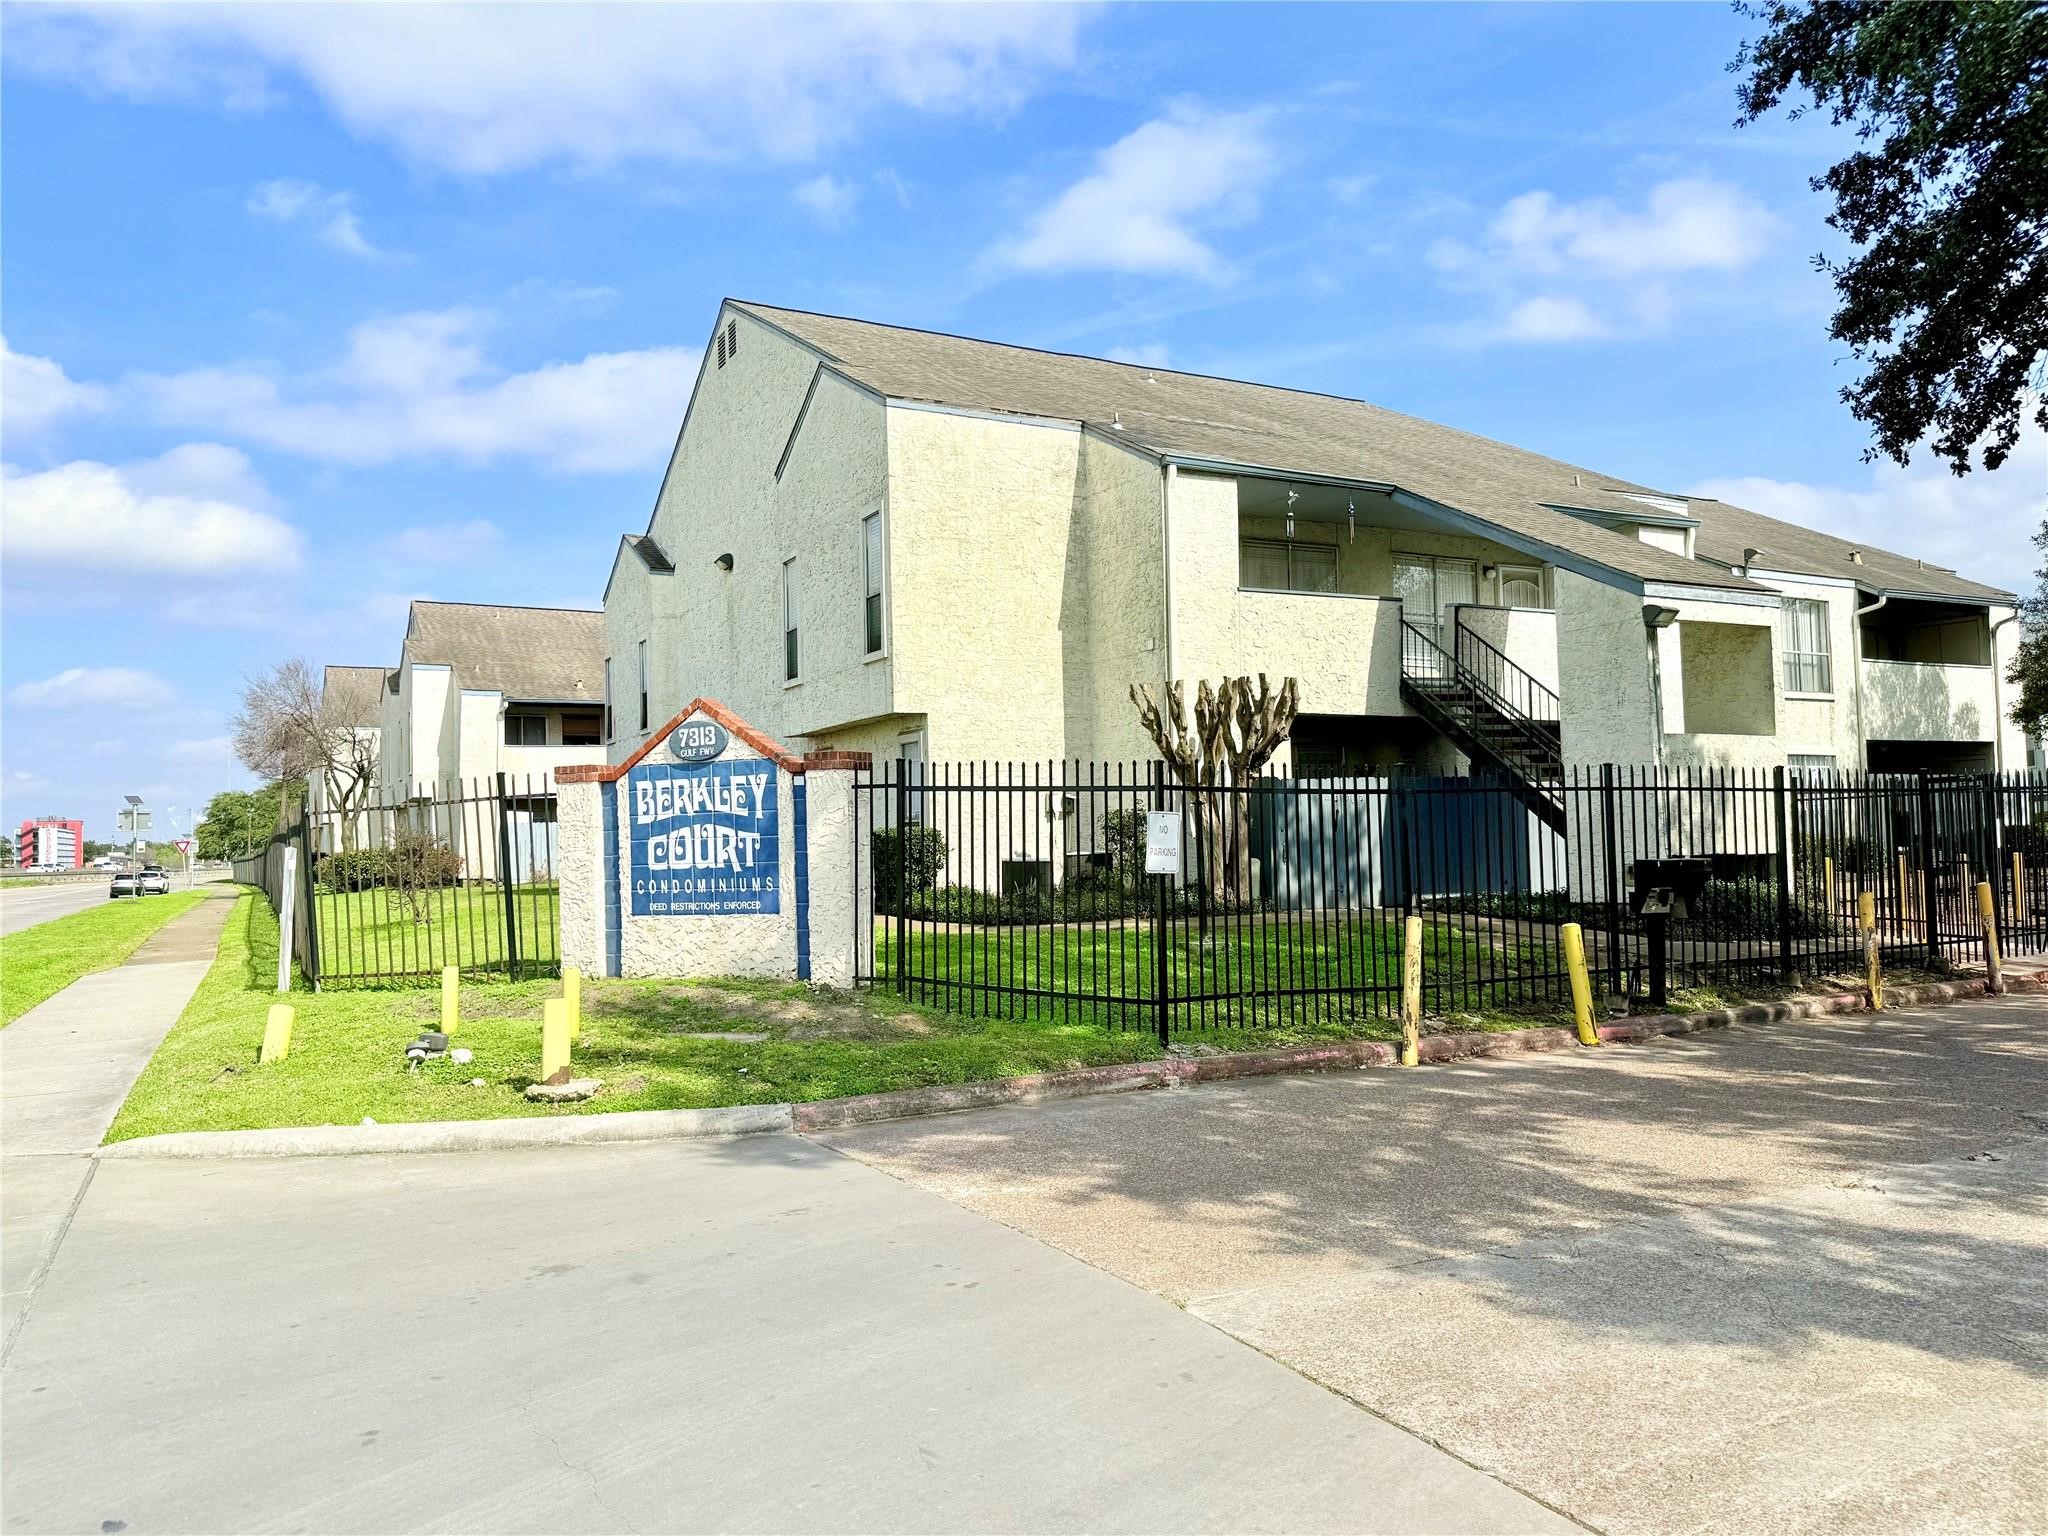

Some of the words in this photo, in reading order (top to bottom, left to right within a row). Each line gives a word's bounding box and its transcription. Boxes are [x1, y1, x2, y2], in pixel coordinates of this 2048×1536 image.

[678, 725, 716, 748] 7313
[680, 748, 697, 757] GULF
[635, 773, 768, 825] BERKLEY
[1159, 825, 1169, 834] NO
[647, 823, 760, 872] COURT
[1149, 847, 1177, 857] PARKING
[637, 876, 774, 894] CONDOMINIUMS
[649, 902, 667, 911] DEED
[670, 901, 720, 911] RESTRICTIONS
[723, 900, 761, 910] ENFORCED
